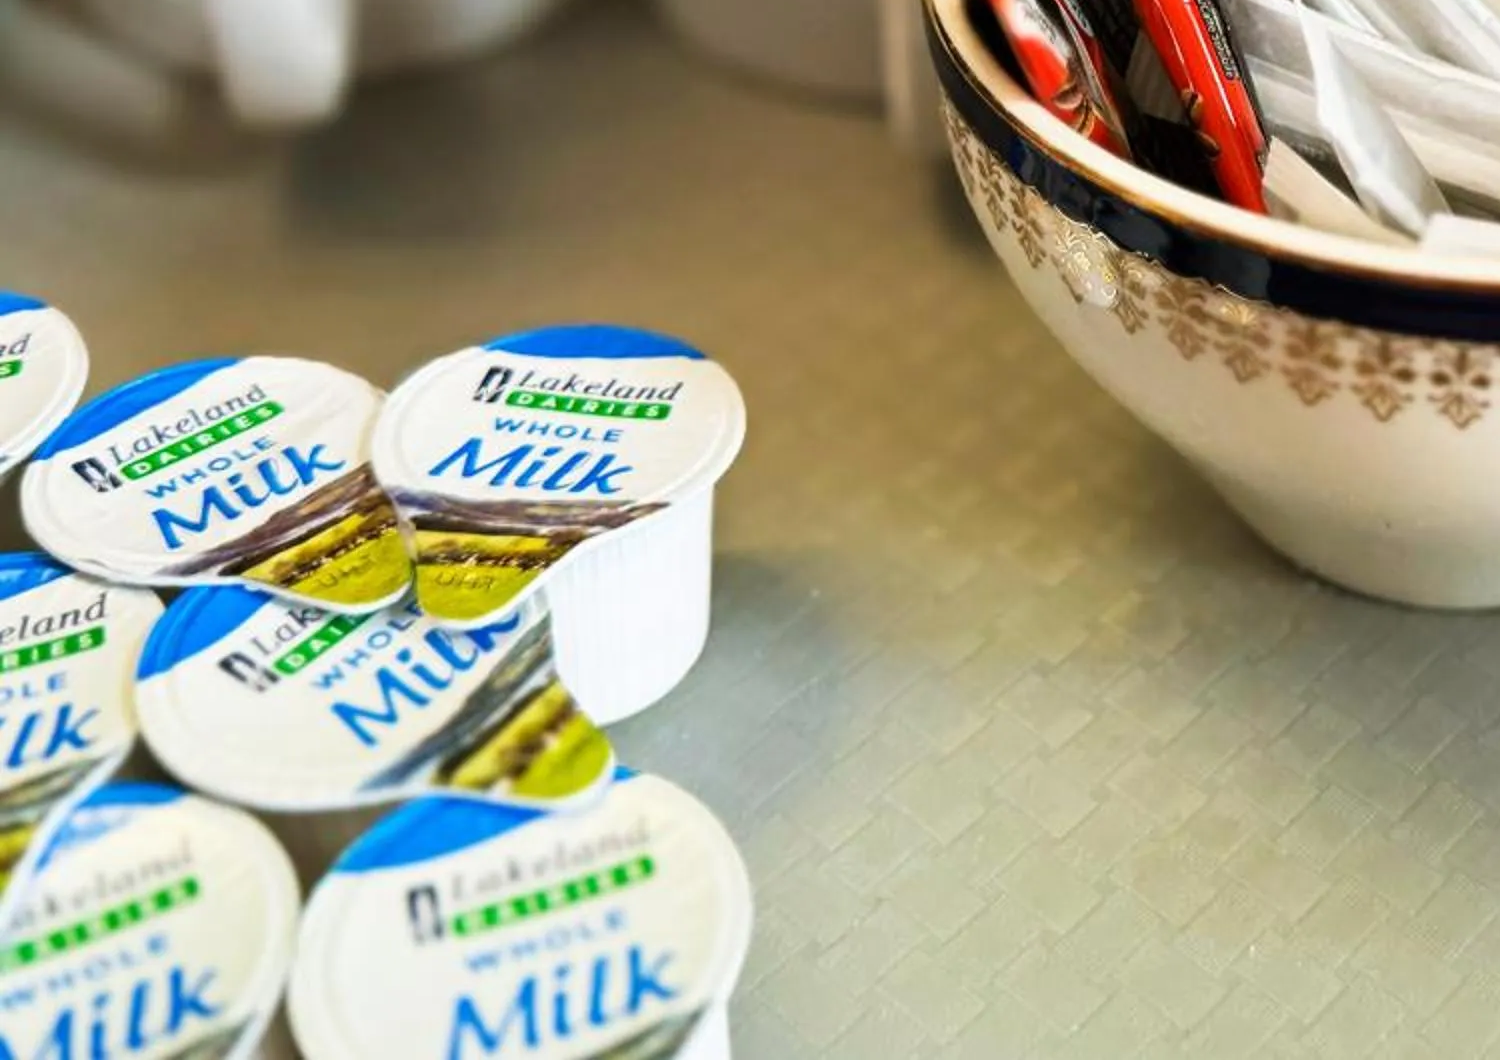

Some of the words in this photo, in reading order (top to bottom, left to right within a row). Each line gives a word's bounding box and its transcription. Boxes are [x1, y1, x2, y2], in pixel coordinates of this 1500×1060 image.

[516, 393, 662, 418] DAIRIES
[518, 369, 685, 403] Lakeland
[107, 385, 268, 466] Lakeland
[132, 403, 276, 477] DAIRIES
[494, 417, 625, 443] WHOLE
[144, 436, 275, 499] WHOLE
[428, 437, 634, 495] Milk
[150, 444, 346, 550] Milk
[0, 592, 107, 641] eland
[2, 631, 95, 669] RIES
[447, 943, 680, 1060] Milk
